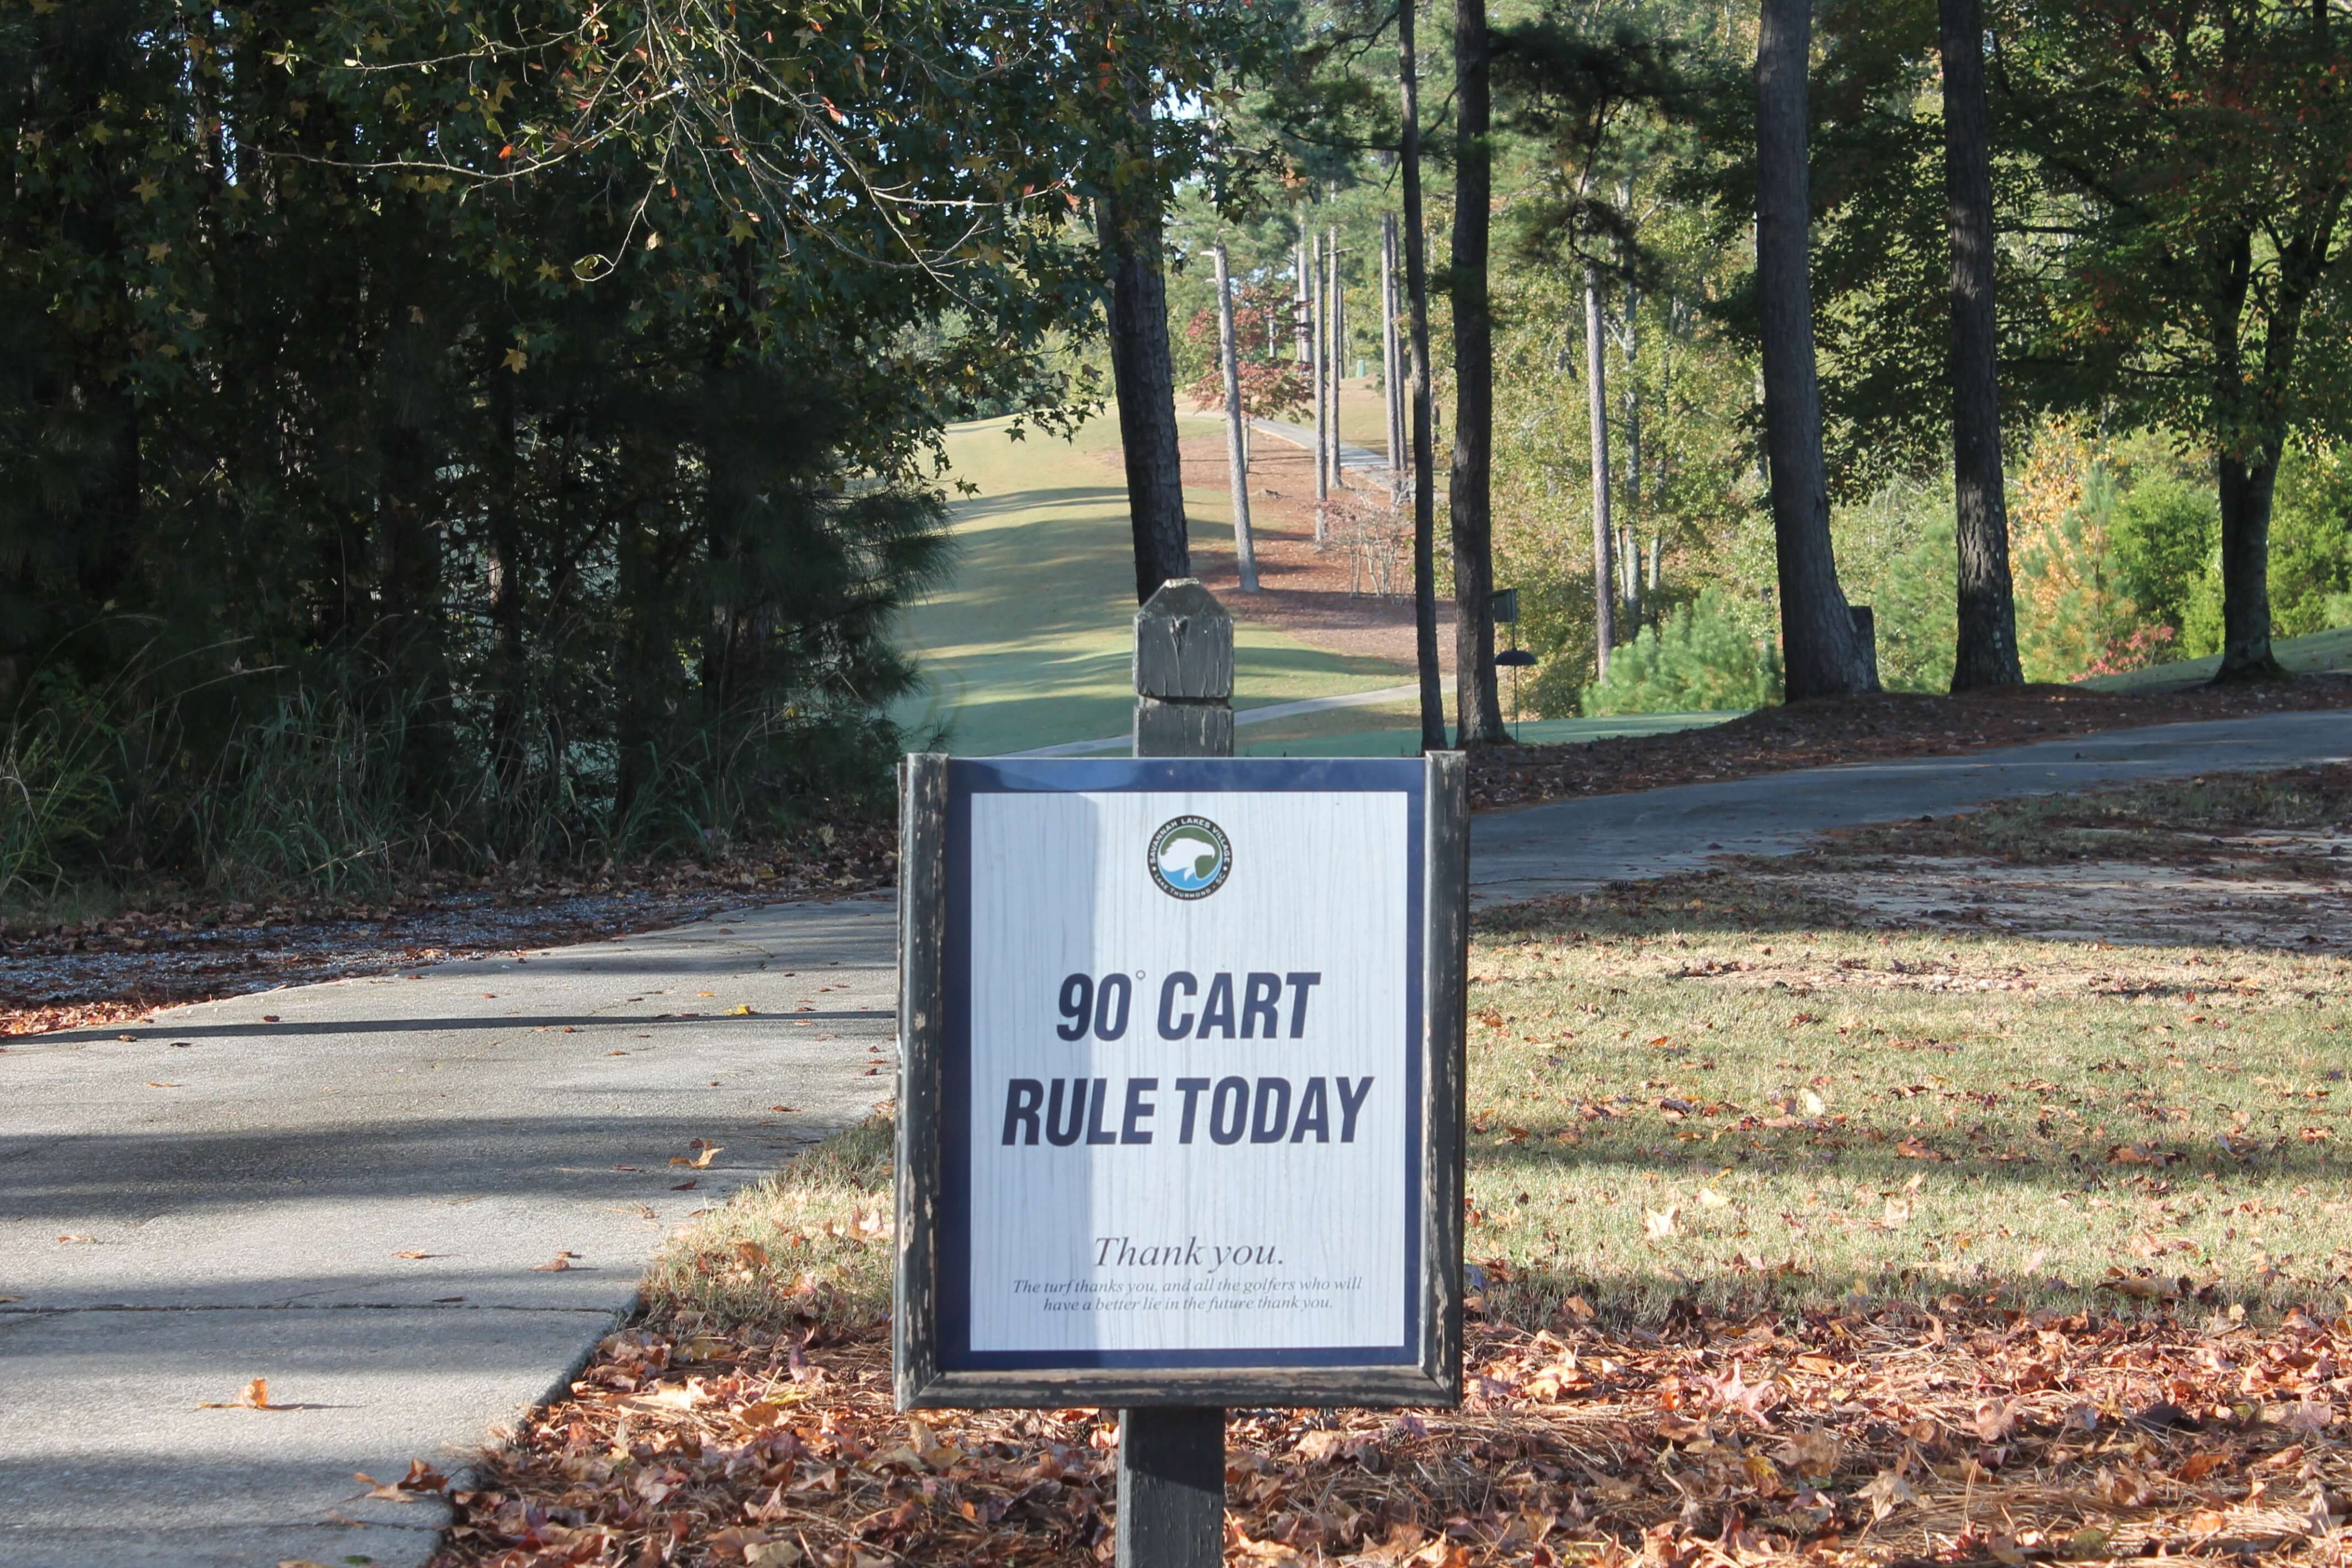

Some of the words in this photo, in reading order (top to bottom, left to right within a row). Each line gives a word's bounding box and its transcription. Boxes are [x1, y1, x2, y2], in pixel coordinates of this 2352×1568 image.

[1149, 820, 1178, 864] SAVANNAH
[1180, 817, 1211, 828] LAKES
[1212, 826, 1231, 863] VILLAGE
[1214, 872, 1227, 885] SC
[1157, 971, 1321, 1040] CART
[1001, 1077, 1158, 1147] RULE
[1175, 1075, 1375, 1145] TODAY
[1094, 1236, 1206, 1267] Thank
[1208, 1244, 1283, 1273] you.
[1013, 1279, 1040, 1294] The
[1044, 1279, 1074, 1296] turf
[1075, 1279, 1124, 1293] thanks
[1125, 1281, 1158, 1295] you,
[1162, 1279, 1192, 1292] and
[1194, 1278, 1214, 1291] all
[1217, 1278, 1240, 1291] the
[1243, 1277, 1295, 1294] golfers
[1300, 1277, 1330, 1291] who
[1334, 1276, 1363, 1290] will
[1043, 1298, 1079, 1311] have
[1082, 1301, 1092, 1311] a
[1095, 1298, 1140, 1311] better
[1143, 1297, 1162, 1311] lie
[1165, 1298, 1179, 1310] in
[1183, 1296, 1206, 1310] the
[1206, 1296, 1255, 1313] future
[1257, 1295, 1298, 1310] thank
[1301, 1298, 1333, 1313] you.
